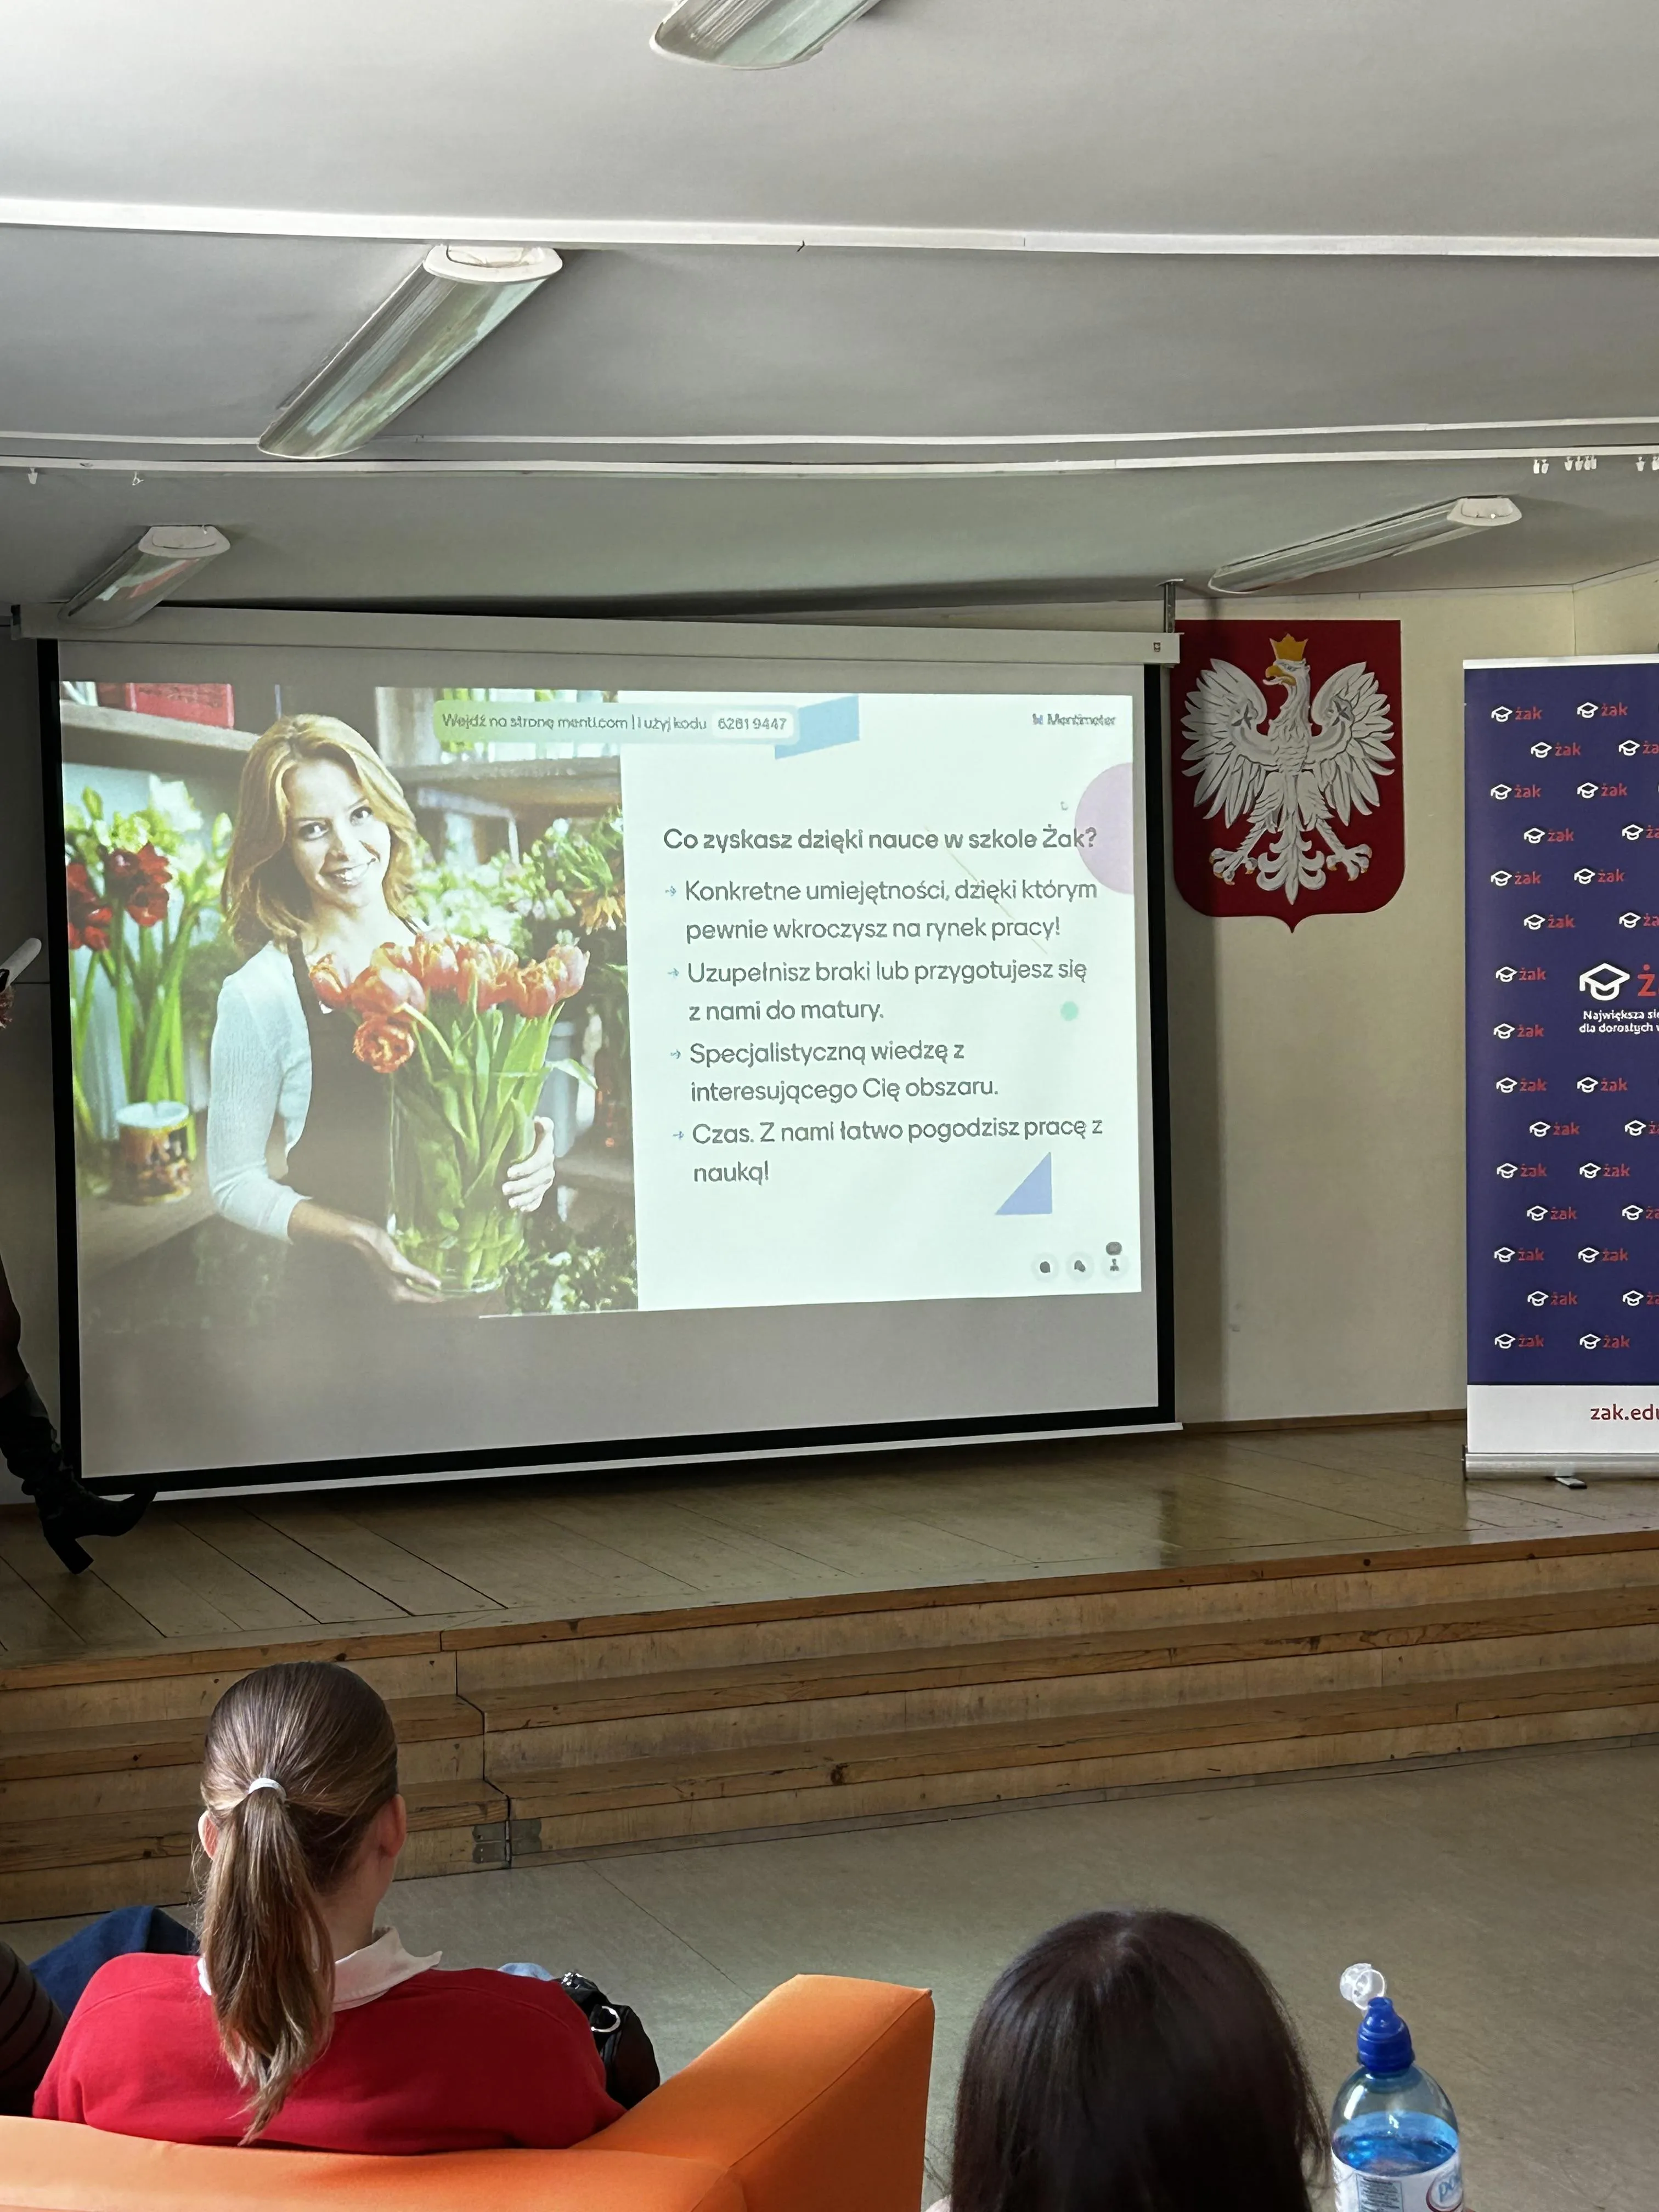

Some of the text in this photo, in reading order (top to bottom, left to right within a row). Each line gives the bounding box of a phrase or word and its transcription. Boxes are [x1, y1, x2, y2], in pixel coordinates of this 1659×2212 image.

[1515, 707, 1542, 720] żak
[1601, 703, 1628, 716] żak
[489, 718, 506, 727] na
[674, 717, 707, 729] kodu
[1555, 743, 1581, 756] żak
[1514, 785, 1541, 798] żak
[1601, 783, 1628, 797] żak
[664, 824, 1097, 854] Co zyskasz dzięki nauce w szkole Żak?
[1547, 828, 1574, 842] żak
[1514, 872, 1541, 885] żak
[1598, 870, 1624, 883] żak
[686, 879, 1097, 905] Konkretne umiejętności, dzięki którym
[1548, 915, 1575, 928] żak
[687, 916, 1059, 944] pewnie wkroczysz na rynek pracy!
[689, 959, 1087, 986] Uzupełnisz braki lub przygotujesz się
[1519, 967, 1546, 981] żak
[689, 1000, 883, 1022] z nami do matury.
[1583, 1009, 1645, 1022] Największa
[1517, 1024, 1544, 1037] żak
[1579, 1023, 1595, 1032] dla
[1599, 1023, 1653, 1035] dorosłych
[690, 1040, 964, 1068] Specjalistyczną wiedzę z
[691, 1077, 998, 1104] interesującego Cię obszaru.
[1520, 1079, 1547, 1092] żak
[1600, 1079, 1628, 1092] żak
[692, 1117, 1103, 1144] Czas. Z nami łatwo pogodzisz pracę z
[1553, 1122, 1579, 1136] żak
[694, 1160, 769, 1185] nauką!
[1520, 1164, 1547, 1177] żak
[1603, 1164, 1630, 1177] żak
[1551, 1207, 1577, 1220] żak
[1518, 1248, 1544, 1261] żak
[1602, 1248, 1628, 1262] żak
[1551, 1292, 1578, 1306] żak
[1518, 1335, 1544, 1348] żak
[1603, 1335, 1630, 1348] żak
